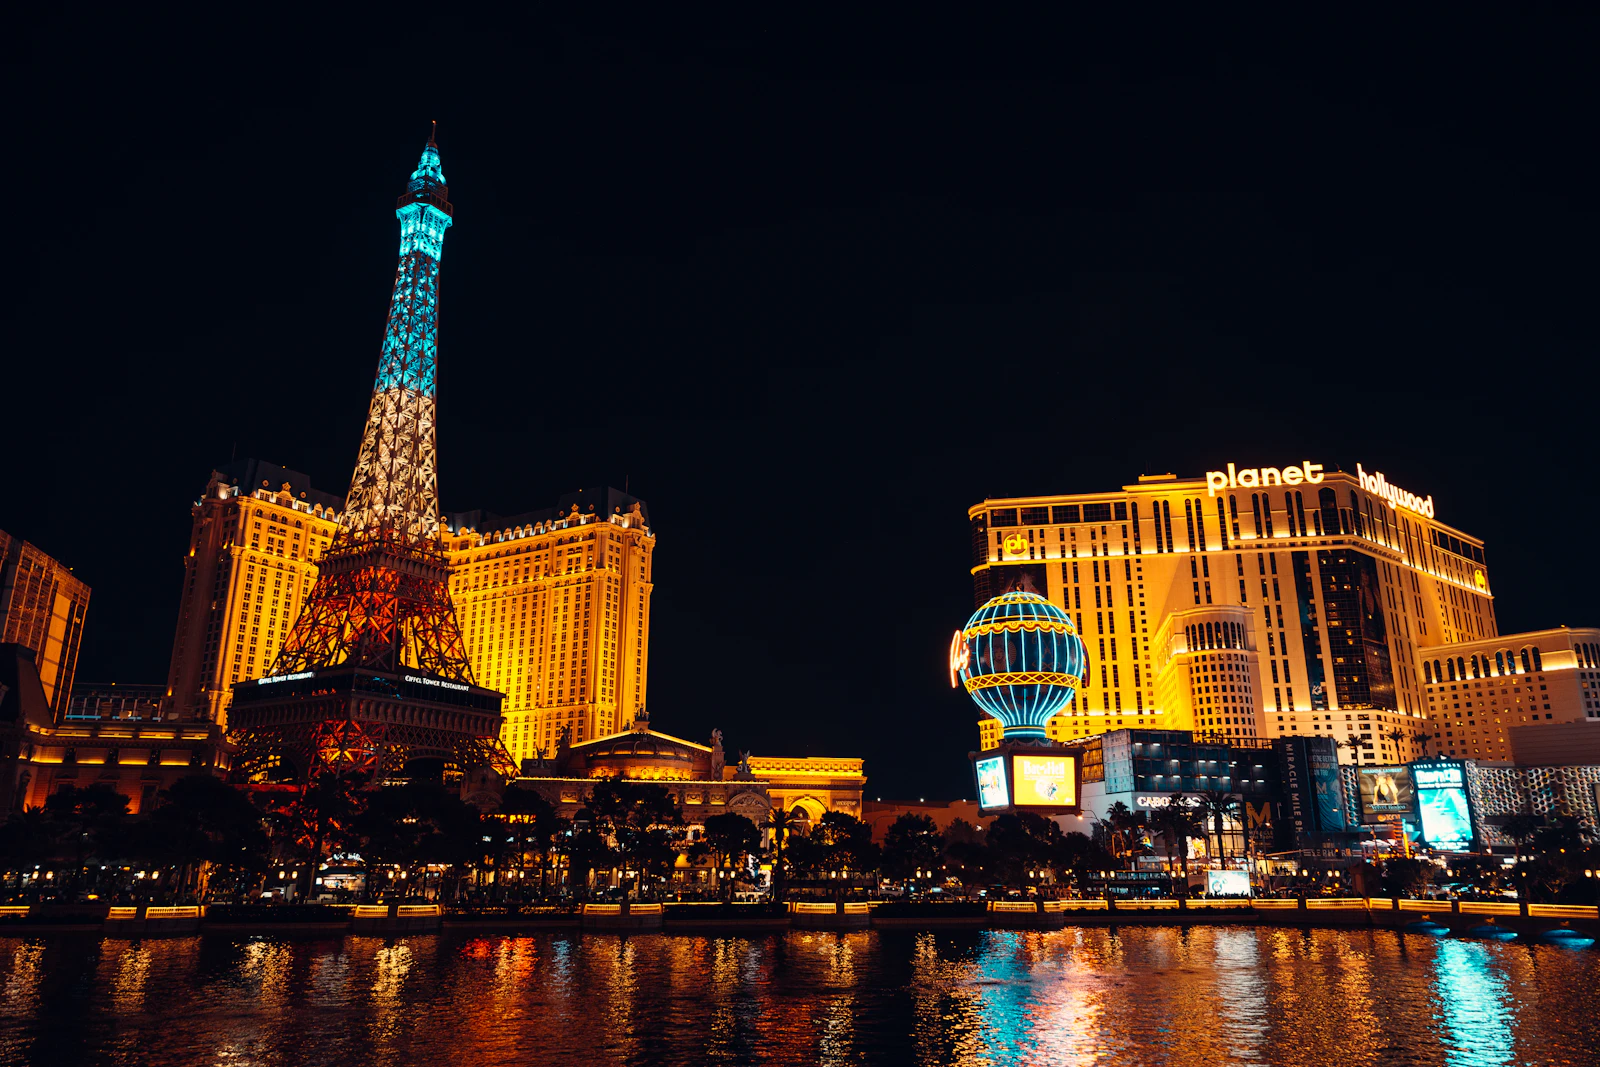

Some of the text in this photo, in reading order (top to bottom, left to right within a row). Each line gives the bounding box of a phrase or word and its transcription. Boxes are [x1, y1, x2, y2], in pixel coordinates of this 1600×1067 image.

[1206, 460, 1435, 519] planet hollywood
[1005, 534, 1028, 554] ph
[404, 674, 470, 692] EIFFEL TOWER RESTAURANT
[1285, 742, 1299, 789] MIRACLE
[1136, 796, 1171, 809] CABO
[1245, 801, 1272, 829] M
[1291, 792, 1302, 817] MILE
